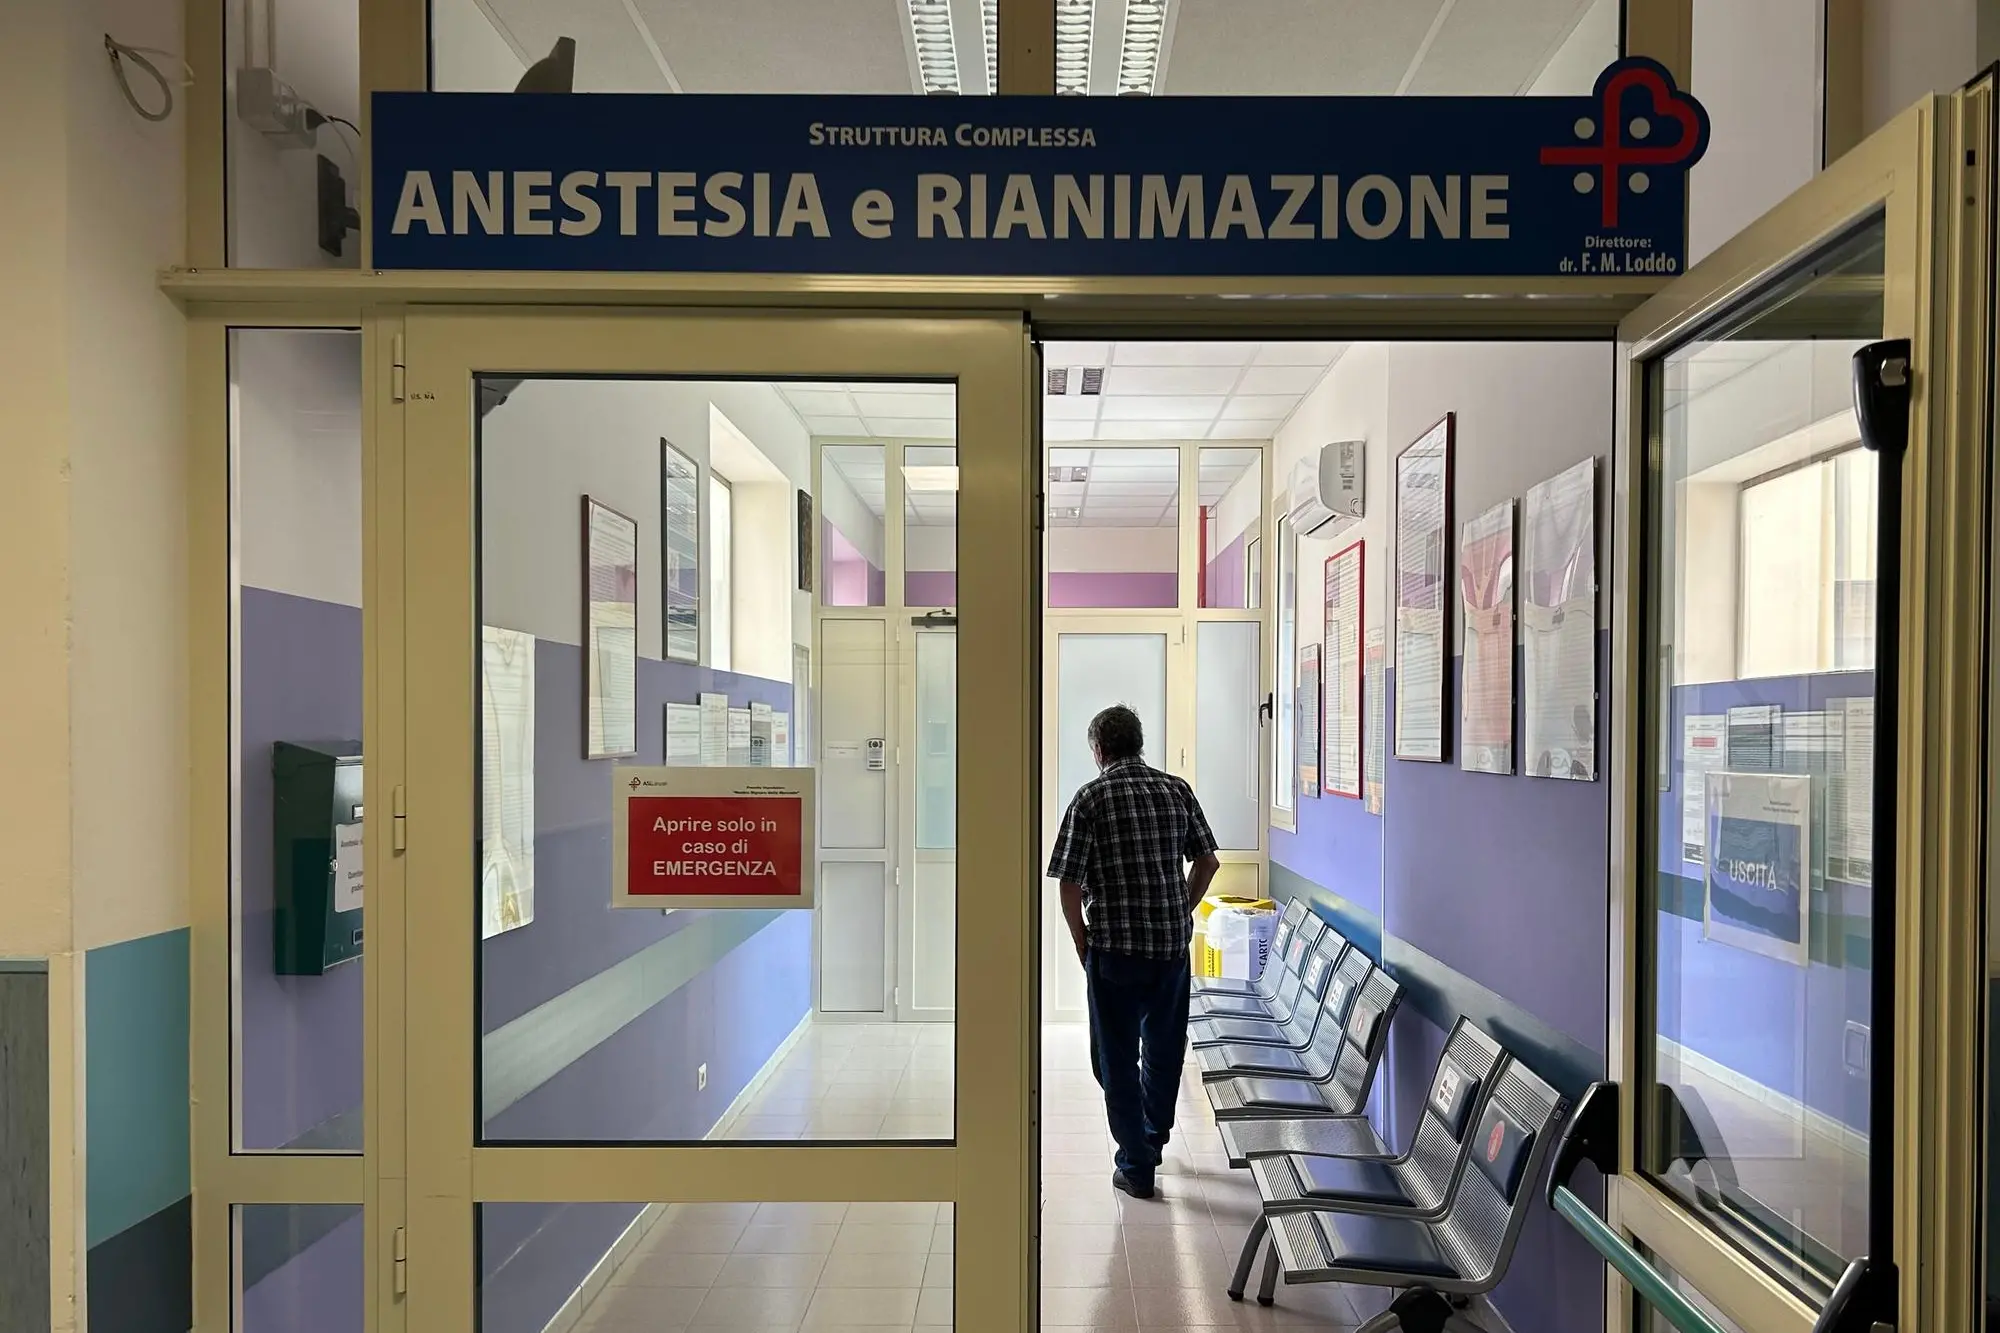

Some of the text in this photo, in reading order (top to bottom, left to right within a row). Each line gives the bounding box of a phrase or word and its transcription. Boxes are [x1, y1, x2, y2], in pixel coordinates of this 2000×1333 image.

[809, 121, 1097, 148] STRUTTURA COMPLESSA
[391, 170, 1511, 241] ANESTESIA e RIANIMAZIONE
[1584, 235, 1652, 249] Direttore:
[1559, 252, 1677, 273] dr. F. M. Loddo
[652, 816, 777, 836] Aprire solo in
[681, 838, 748, 855] caso di
[653, 860, 777, 876] EMERGENZA
[1729, 859, 1777, 890] USCITA
